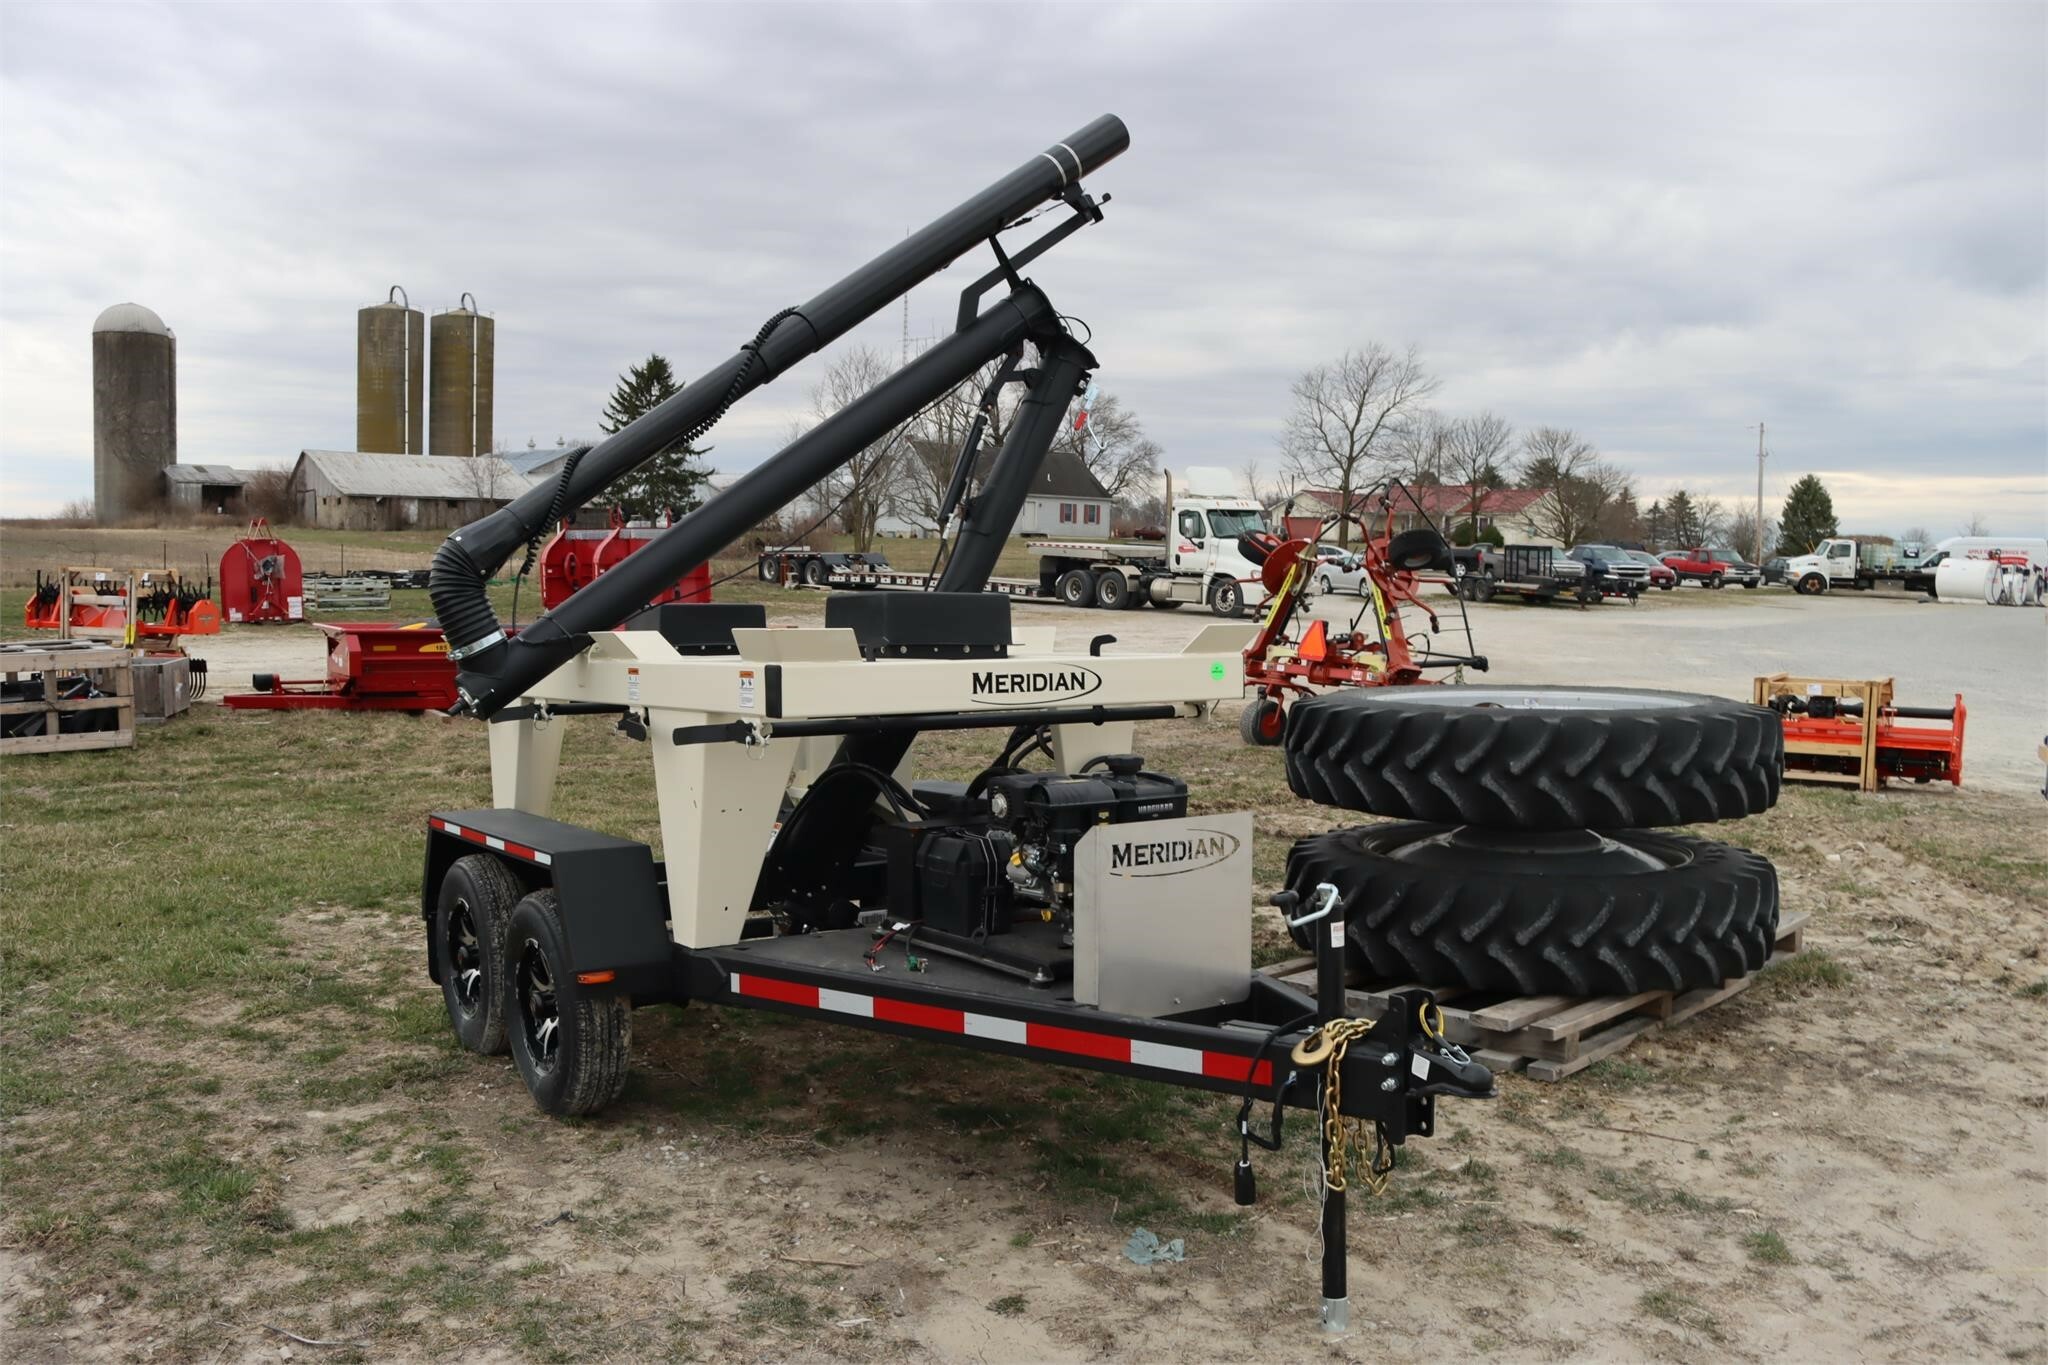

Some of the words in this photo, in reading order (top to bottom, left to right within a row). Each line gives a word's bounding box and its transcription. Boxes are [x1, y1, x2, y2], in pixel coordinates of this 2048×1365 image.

[972, 672, 1085, 694] MERIDIAN
[1138, 803, 1173, 814] VANGUARD
[1111, 837, 1225, 868] MERIDIAN
